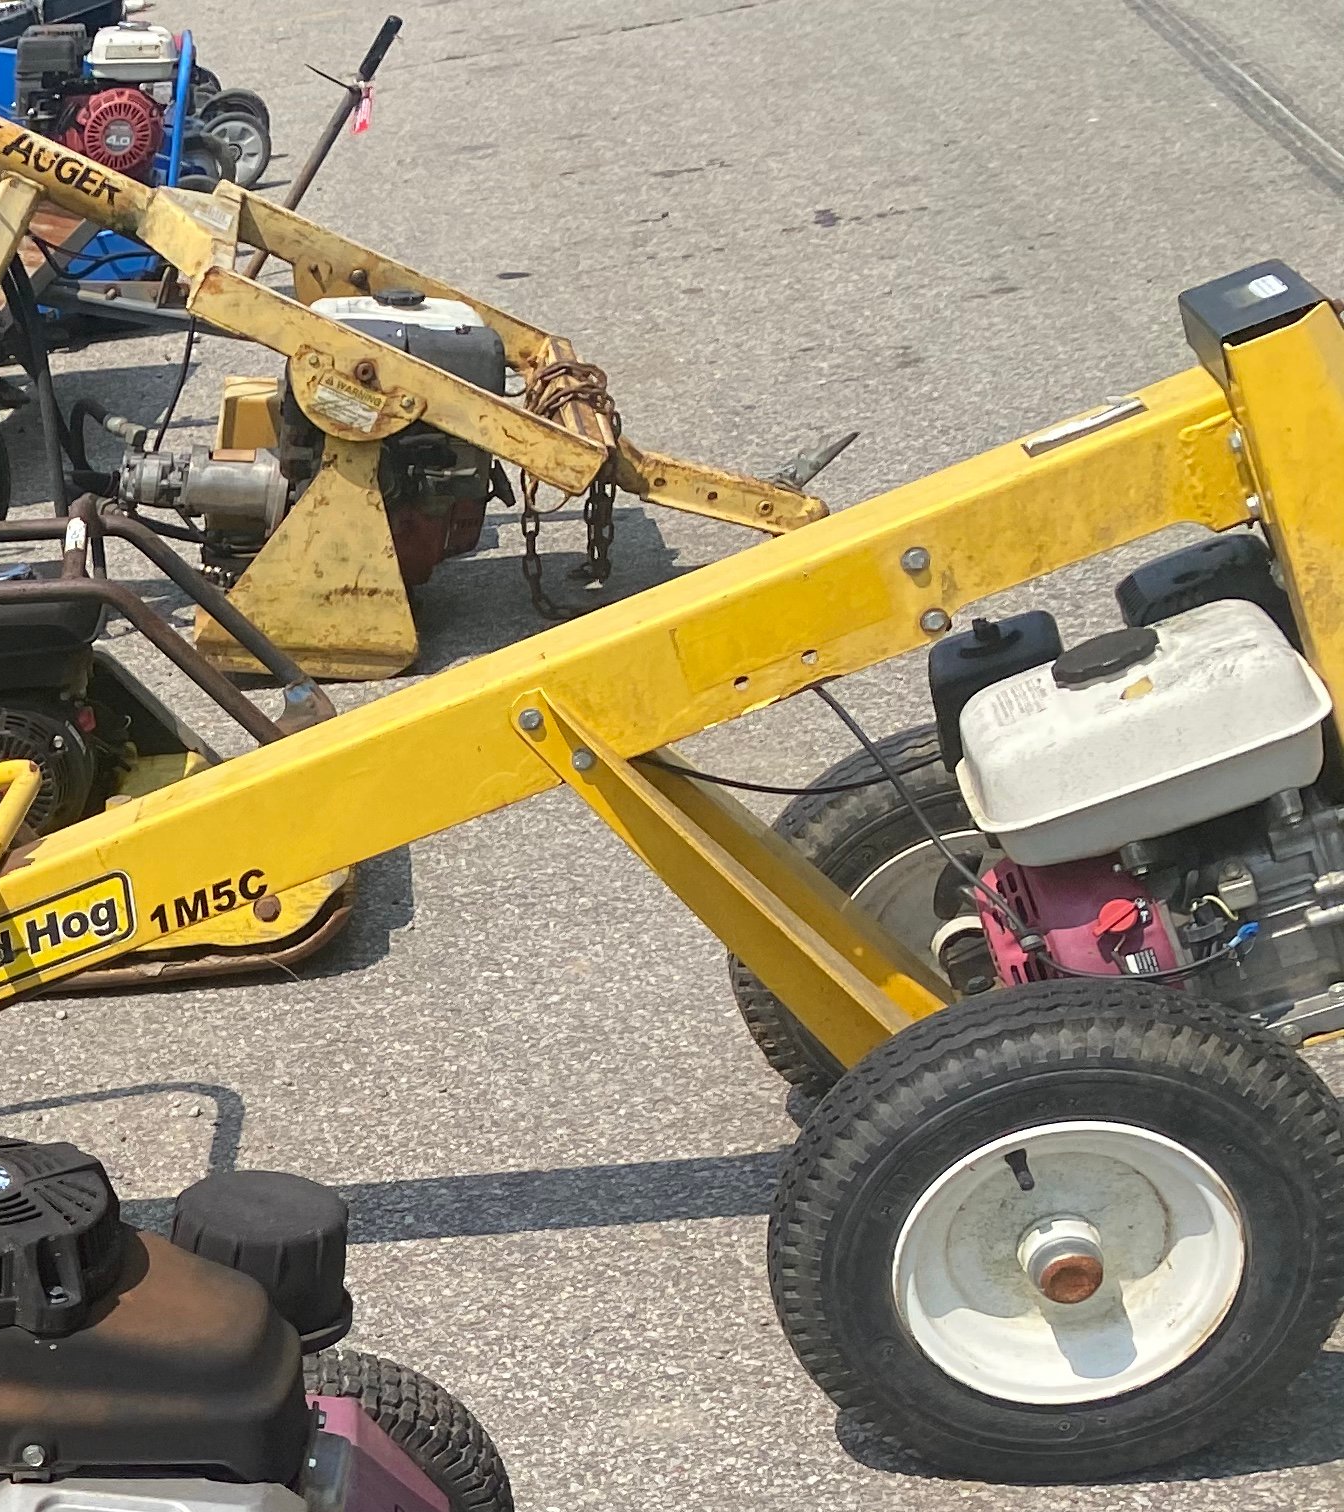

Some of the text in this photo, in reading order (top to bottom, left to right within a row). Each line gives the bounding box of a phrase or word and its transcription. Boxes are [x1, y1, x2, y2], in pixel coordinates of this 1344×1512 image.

[2, 132, 123, 207] AUGER
[336, 380, 384, 407] WARNING
[27, 895, 119, 954] Hog
[148, 868, 270, 934] 1M5C
